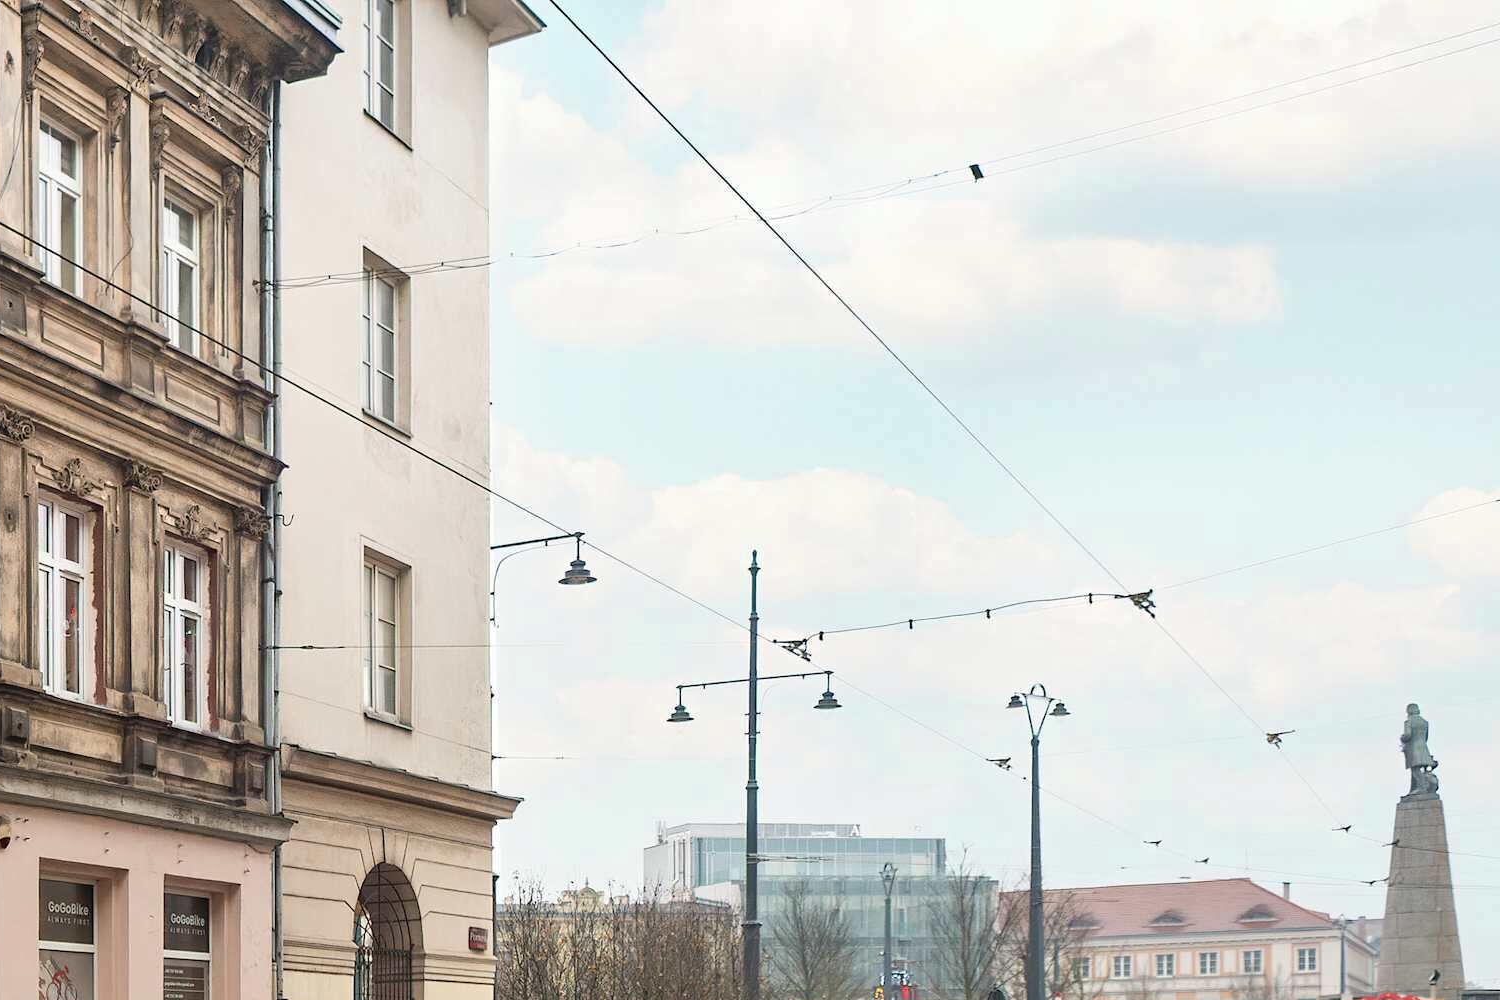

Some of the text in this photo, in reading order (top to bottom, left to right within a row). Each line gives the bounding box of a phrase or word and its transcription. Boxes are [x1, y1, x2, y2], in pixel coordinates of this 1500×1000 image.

[48, 901, 89, 915] GoGoBike
[47, 917, 90, 927] ALWAYS FIRST
[171, 913, 205, 927] GoGoBike
